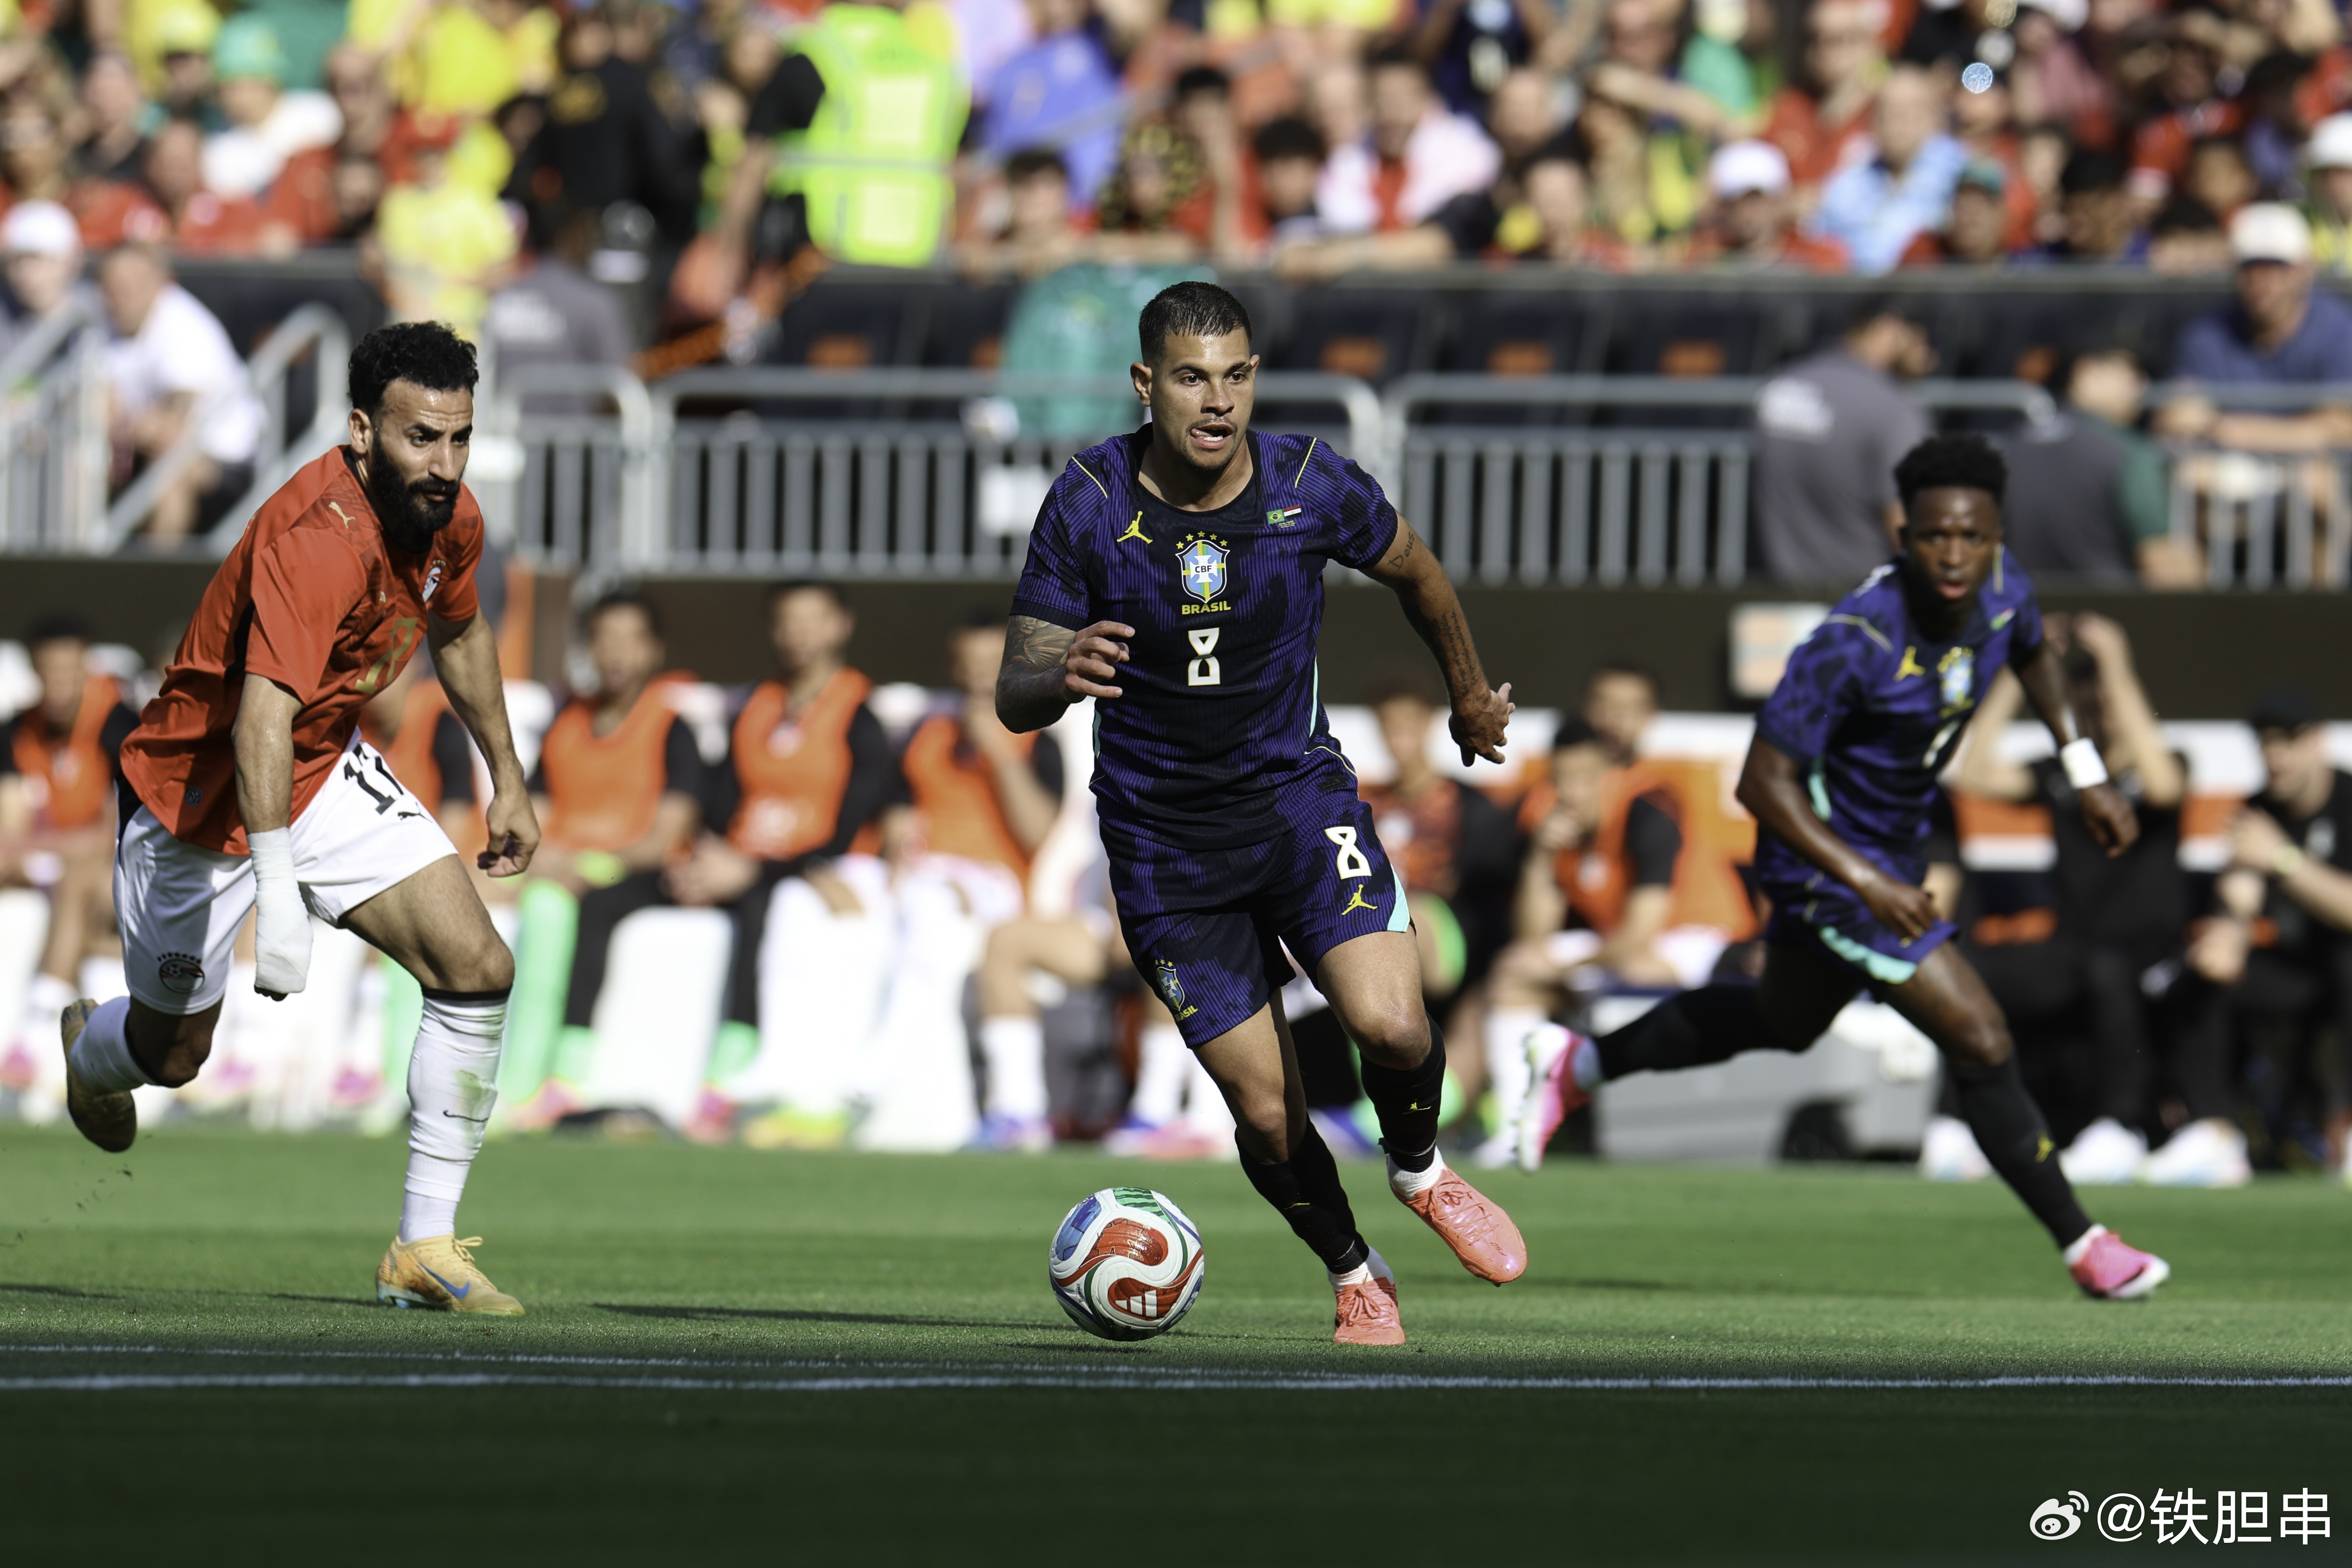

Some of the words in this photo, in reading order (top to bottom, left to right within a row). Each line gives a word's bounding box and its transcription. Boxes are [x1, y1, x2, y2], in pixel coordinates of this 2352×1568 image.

[1182, 601, 1231, 615] BRASIL
[1188, 627, 1221, 686] 8
[344, 742, 404, 815] 17
[1324, 826, 1372, 880] 8
